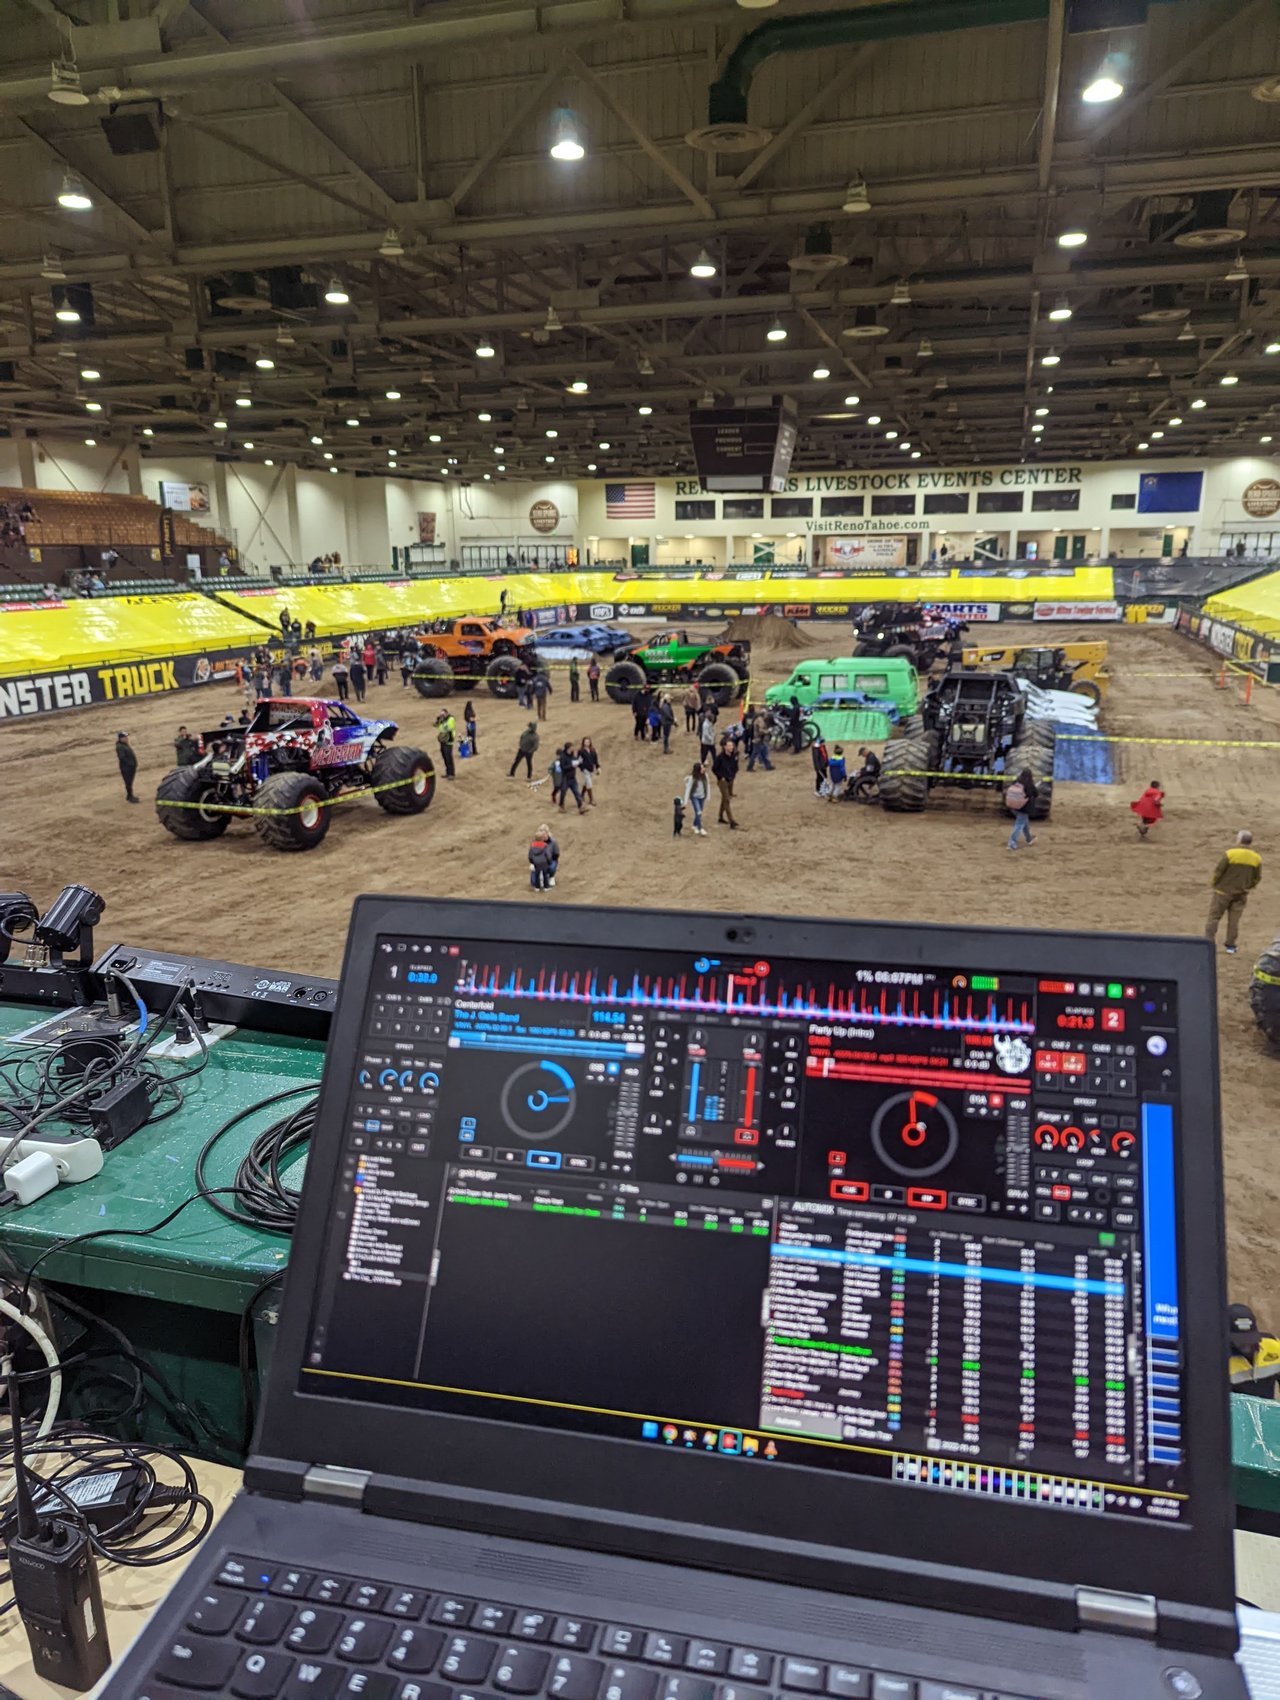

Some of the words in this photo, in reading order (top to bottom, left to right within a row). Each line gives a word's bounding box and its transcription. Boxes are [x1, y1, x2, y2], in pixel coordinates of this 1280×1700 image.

[805, 473, 910, 491] LIVESTOCK
[917, 470, 993, 488] EVENTS
[1000, 467, 1082, 485] CENTER
[805, 519, 930, 532] VisitRenoTahoe.com
[97, 660, 180, 700] TRUCK
[455, 1000, 494, 1010] Centerfold
[1107, 1012, 1119, 1027] 2
[792, 1201, 835, 1215] AUTOMIX
[289, 1627, 306, 1643] 2
[340, 1636, 356, 1652] 3
[392, 1646, 407, 1661] 4
[245, 1654, 266, 1674] Q
[443, 1655, 460, 1671] 5
[299, 1663, 322, 1683] W
[497, 1665, 513, 1681] 6
[348, 1673, 368, 1692] E
[551, 1675, 568, 1691] 7
[401, 1683, 421, 1700] R
